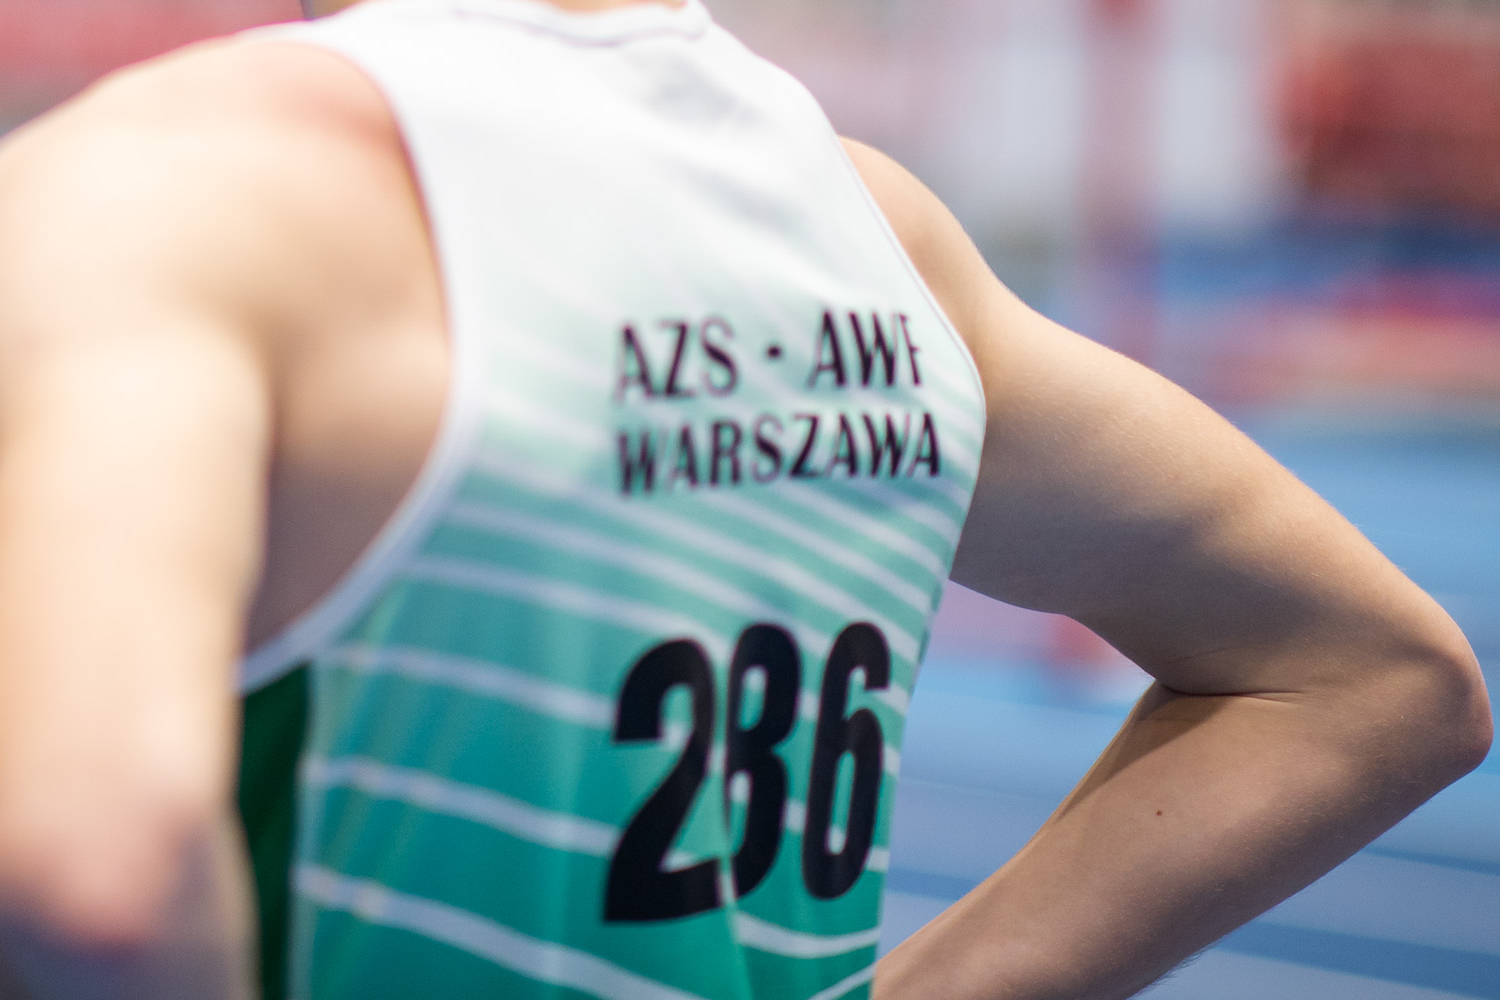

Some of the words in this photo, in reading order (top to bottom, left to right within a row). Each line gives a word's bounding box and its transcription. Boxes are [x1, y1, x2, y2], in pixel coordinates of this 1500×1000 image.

[615, 316, 738, 402] AZS
[617, 412, 940, 496] WARSZAWA
[603, 621, 892, 924] 286
